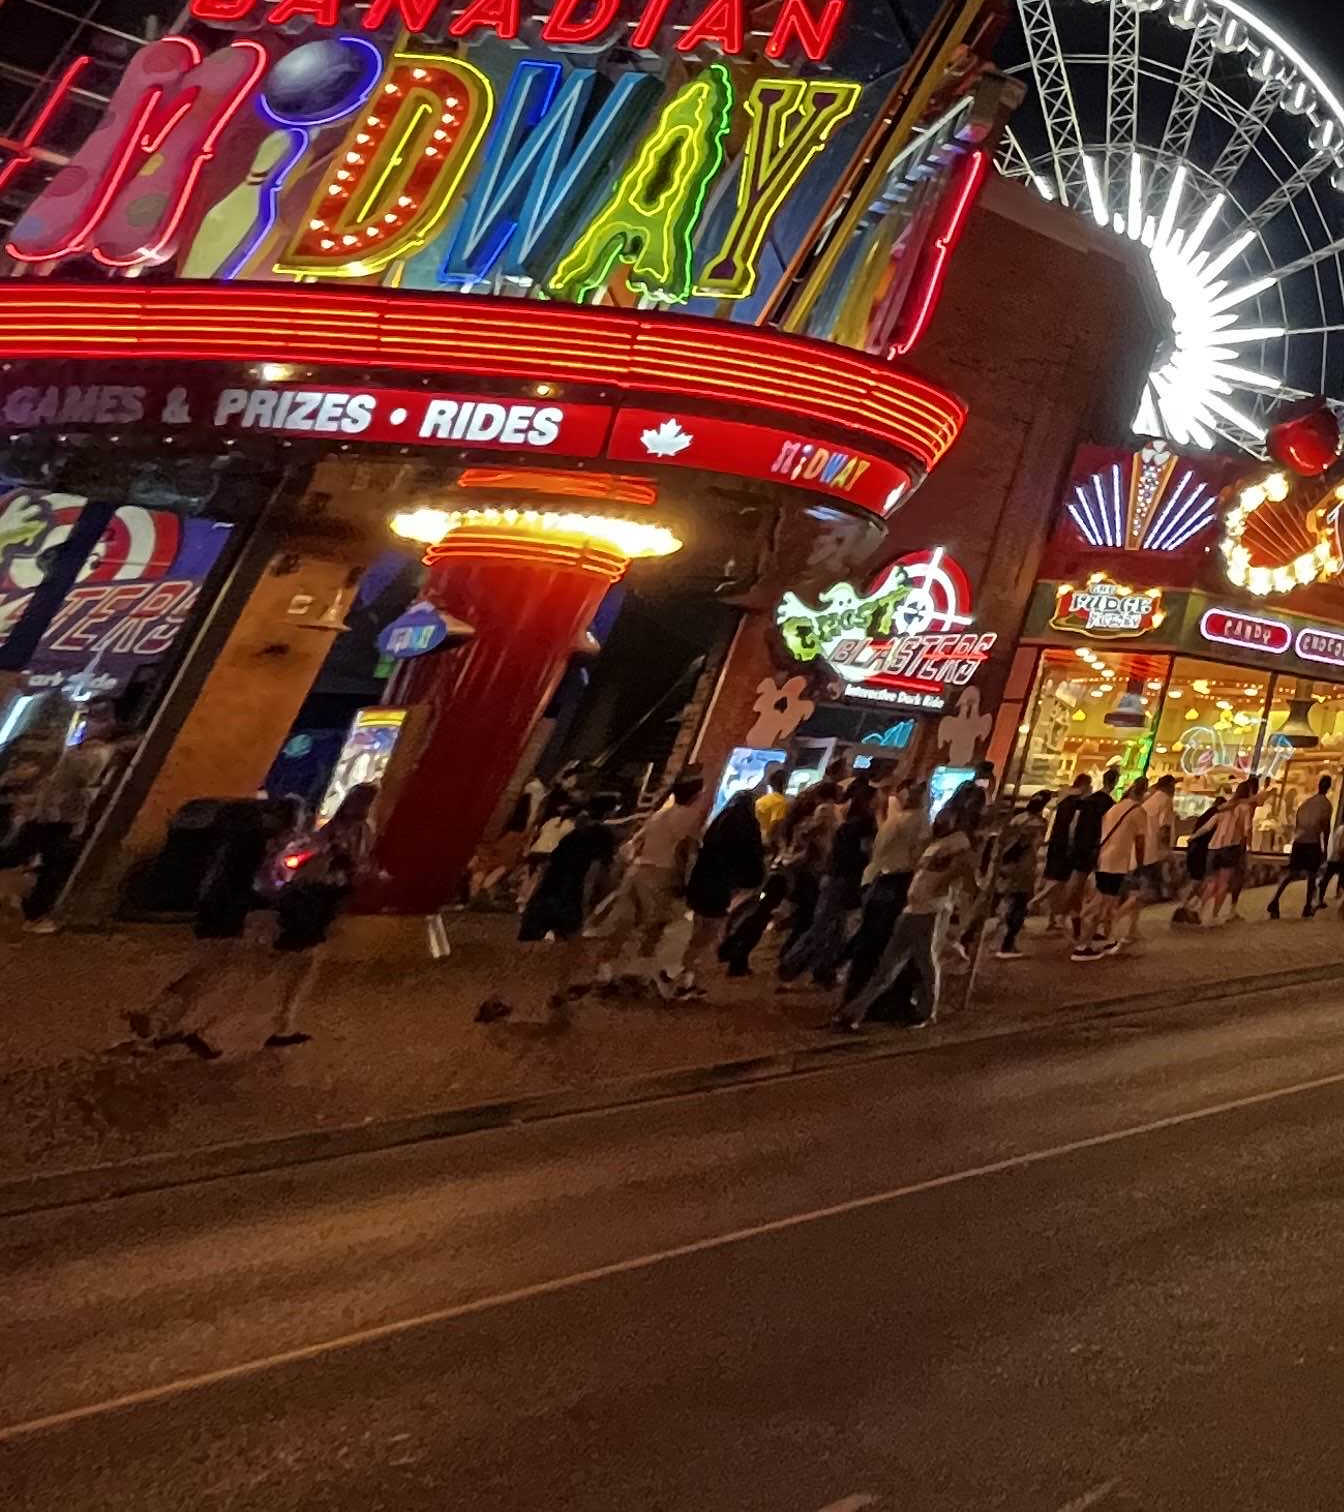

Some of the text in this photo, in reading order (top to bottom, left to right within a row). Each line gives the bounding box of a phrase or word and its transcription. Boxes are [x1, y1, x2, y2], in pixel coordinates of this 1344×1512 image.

[1, 386, 564, 447] GAMES & PRIZES RIDES
[0, 580, 204, 656] TERS
[1224, 619, 1272, 645] CANDY
[22, 669, 66, 687] ark
[828, 632, 998, 686] BLASTERS
[897, 691, 922, 706] Dark
[922, 695, 945, 709] Ride
